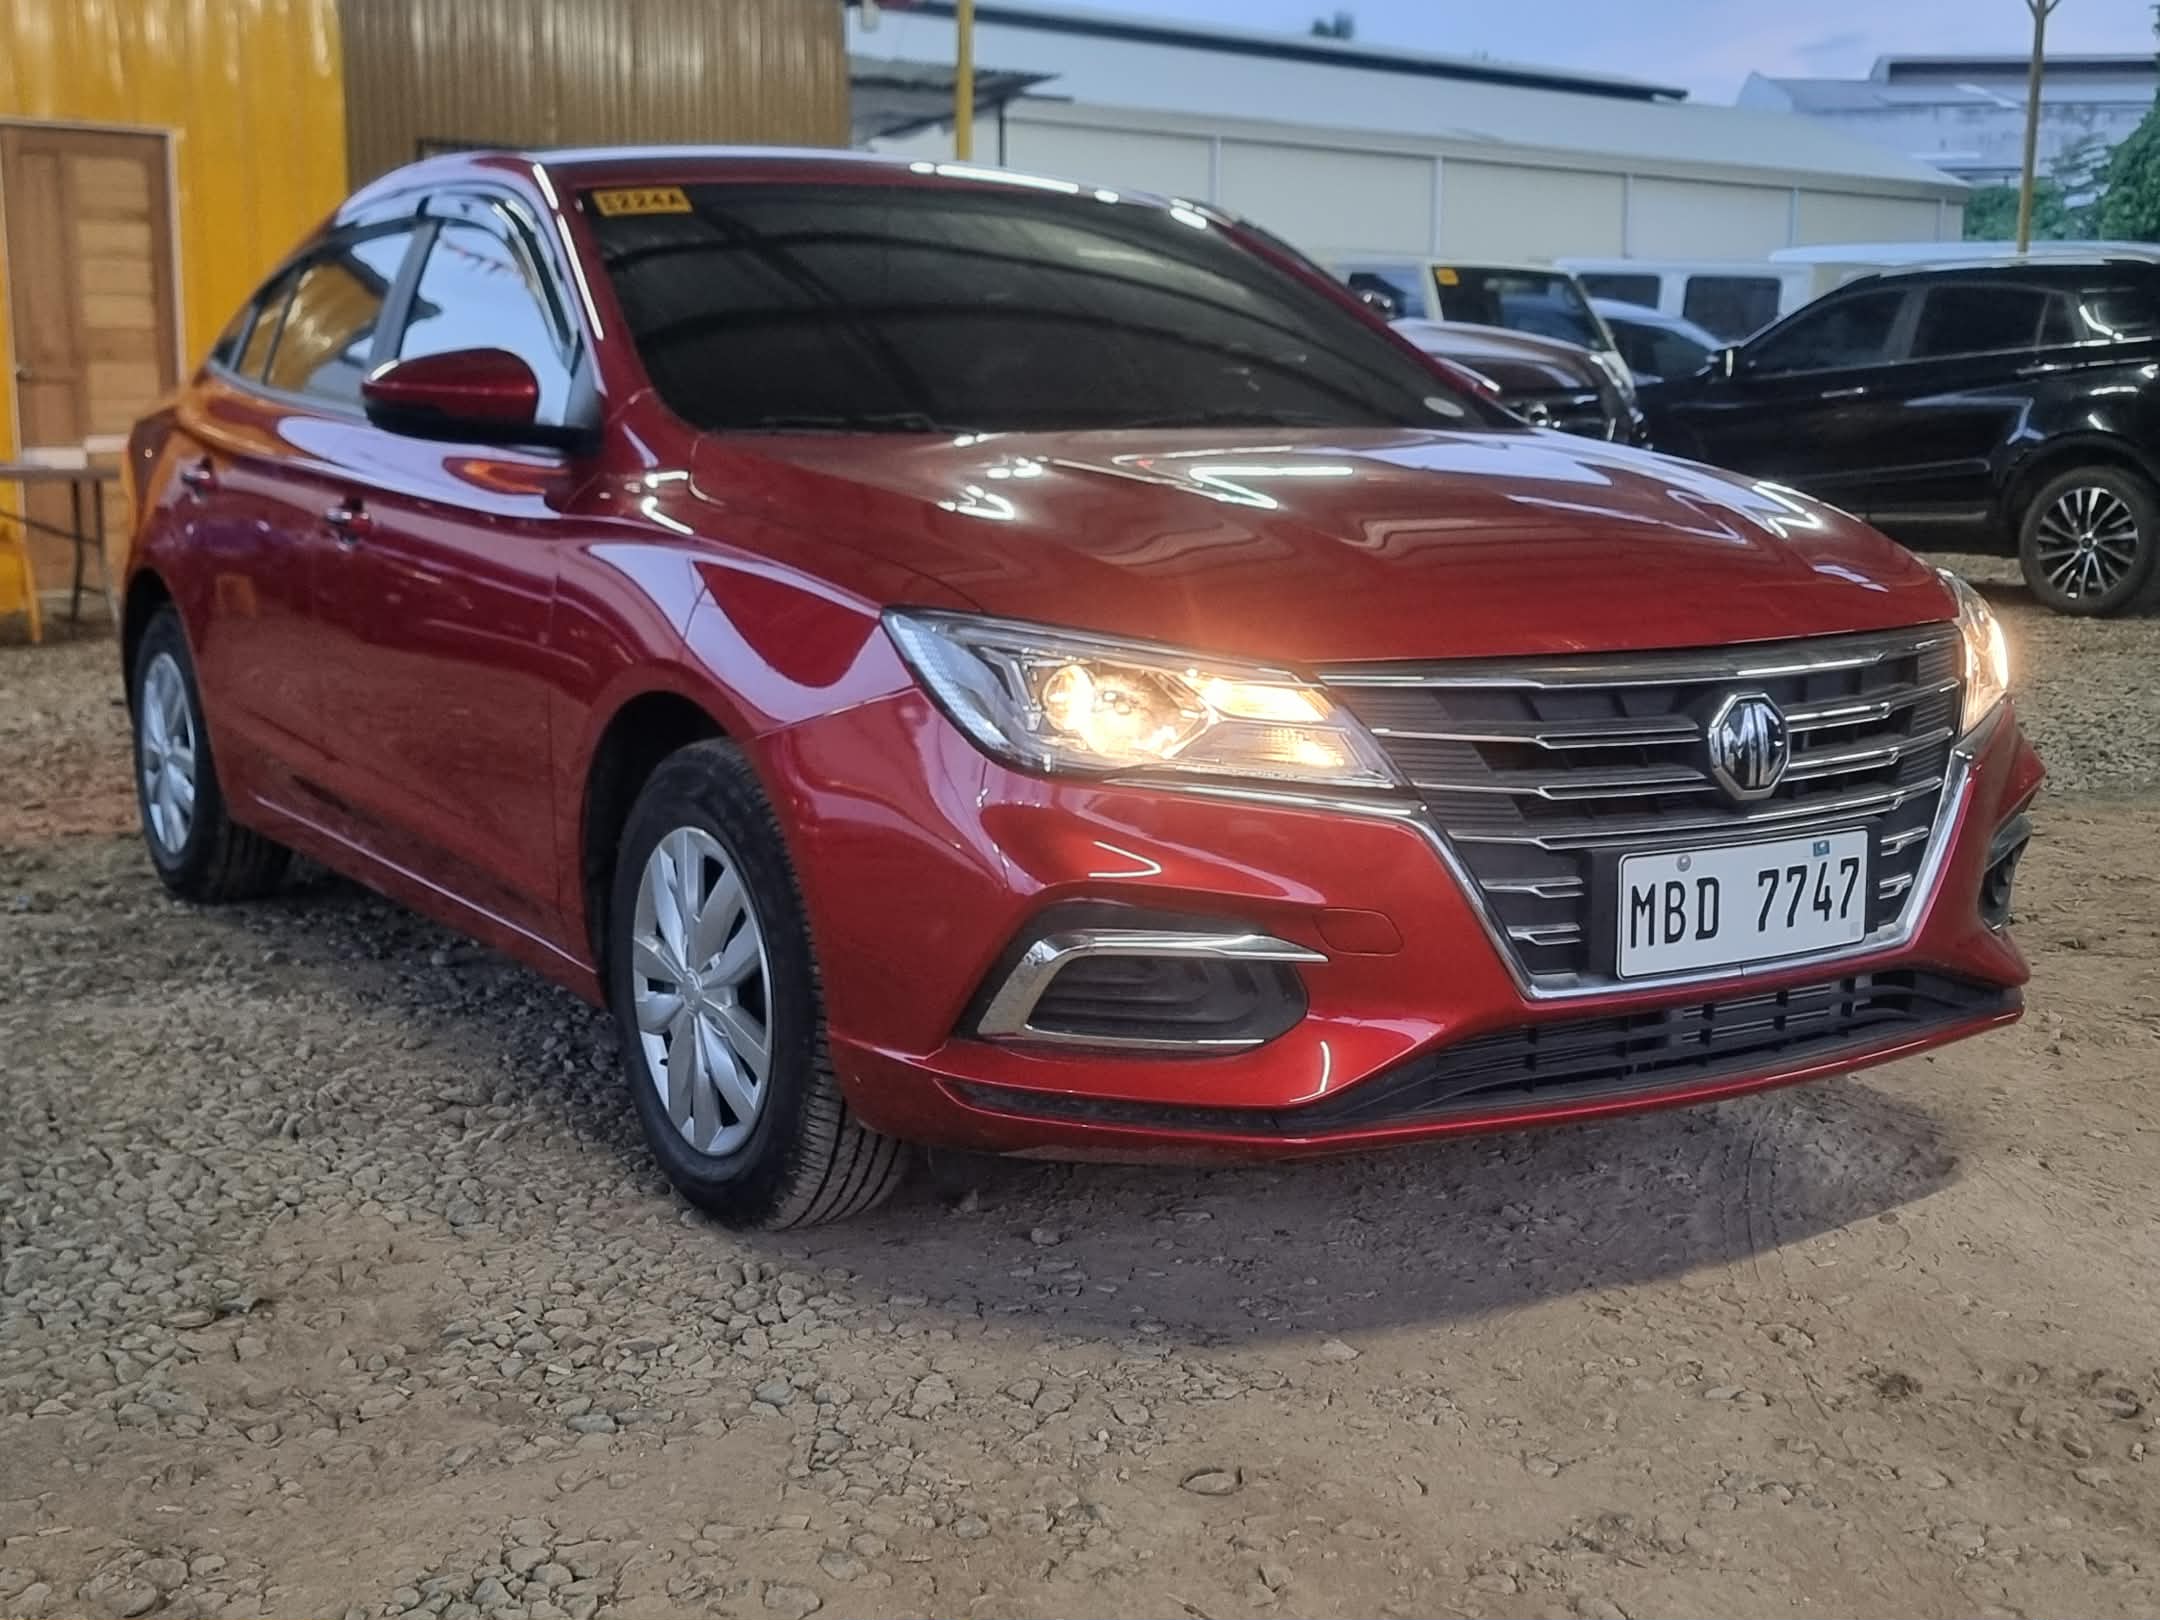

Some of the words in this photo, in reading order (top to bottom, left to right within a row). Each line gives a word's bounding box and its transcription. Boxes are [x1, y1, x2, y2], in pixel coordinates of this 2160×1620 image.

[1721, 703, 1783, 786] MG
[1630, 876, 1720, 949] MBD
[1757, 857, 1860, 933] 7747
